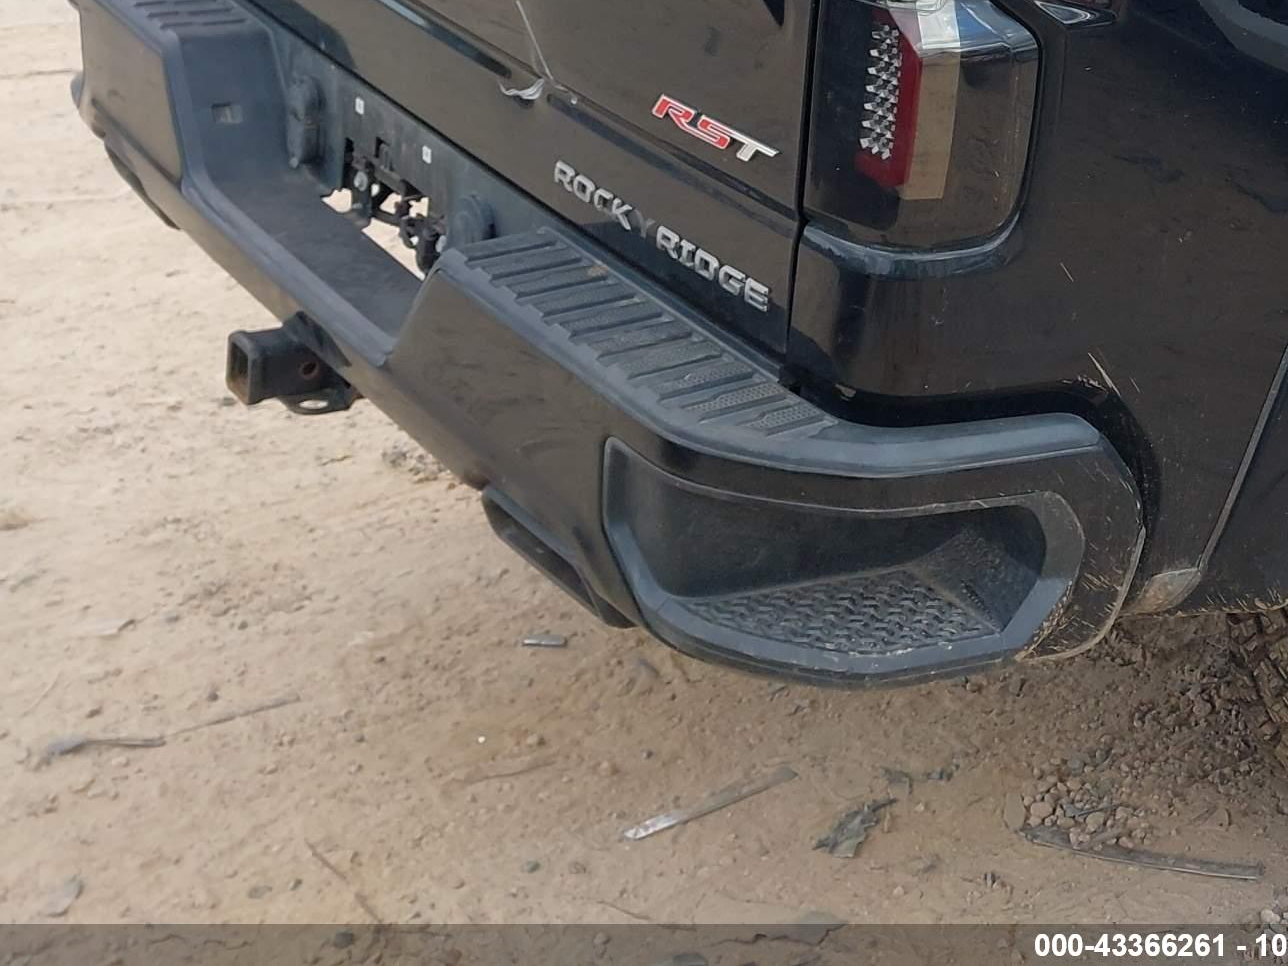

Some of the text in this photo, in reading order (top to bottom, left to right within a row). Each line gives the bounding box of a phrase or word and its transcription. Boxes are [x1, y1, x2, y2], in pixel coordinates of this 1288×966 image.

[651, 93, 782, 162] RST
[554, 159, 770, 313] ROCK RIDGE
